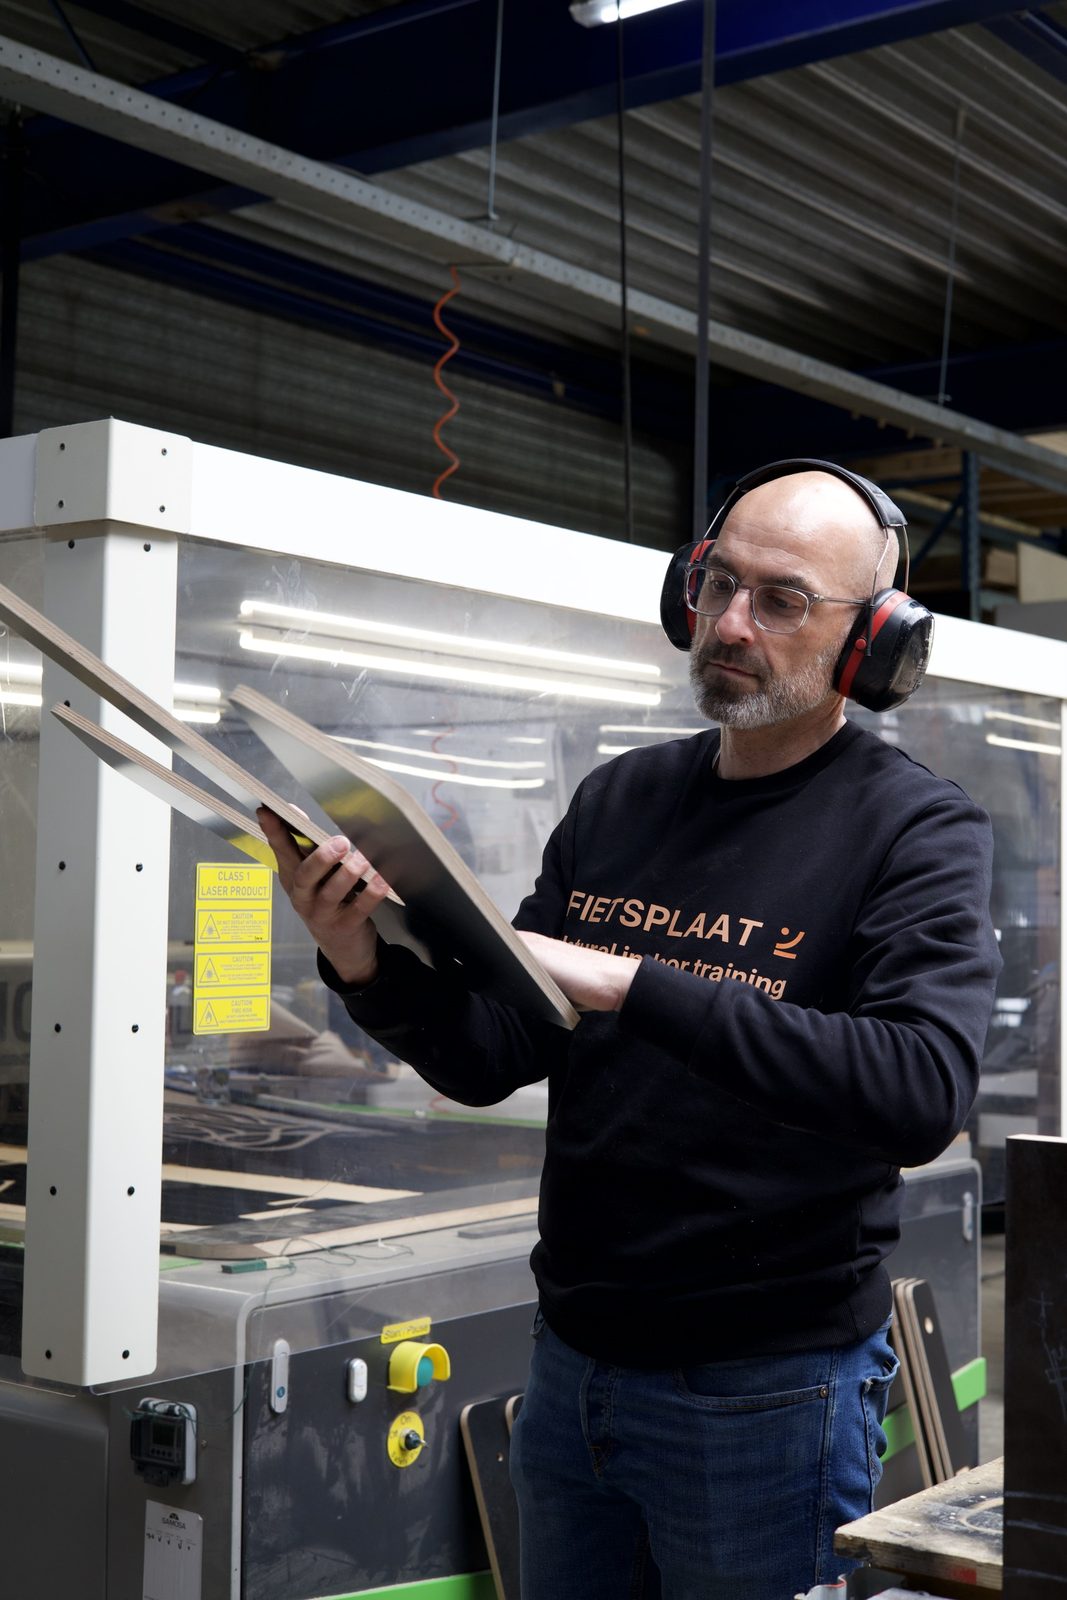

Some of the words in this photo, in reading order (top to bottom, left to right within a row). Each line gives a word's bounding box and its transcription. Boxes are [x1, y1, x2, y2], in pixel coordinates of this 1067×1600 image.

[217, 871, 244, 882] CLASS
[246, 871, 251, 881] 1
[201, 886, 228, 897] LASER
[230, 886, 268, 897] PRODUCT
[566, 890, 764, 947] FIETSPLAAT
[232, 955, 254, 963] CAUTION
[692, 958, 788, 1000] training
[231, 999, 253, 1007] CAUTION
